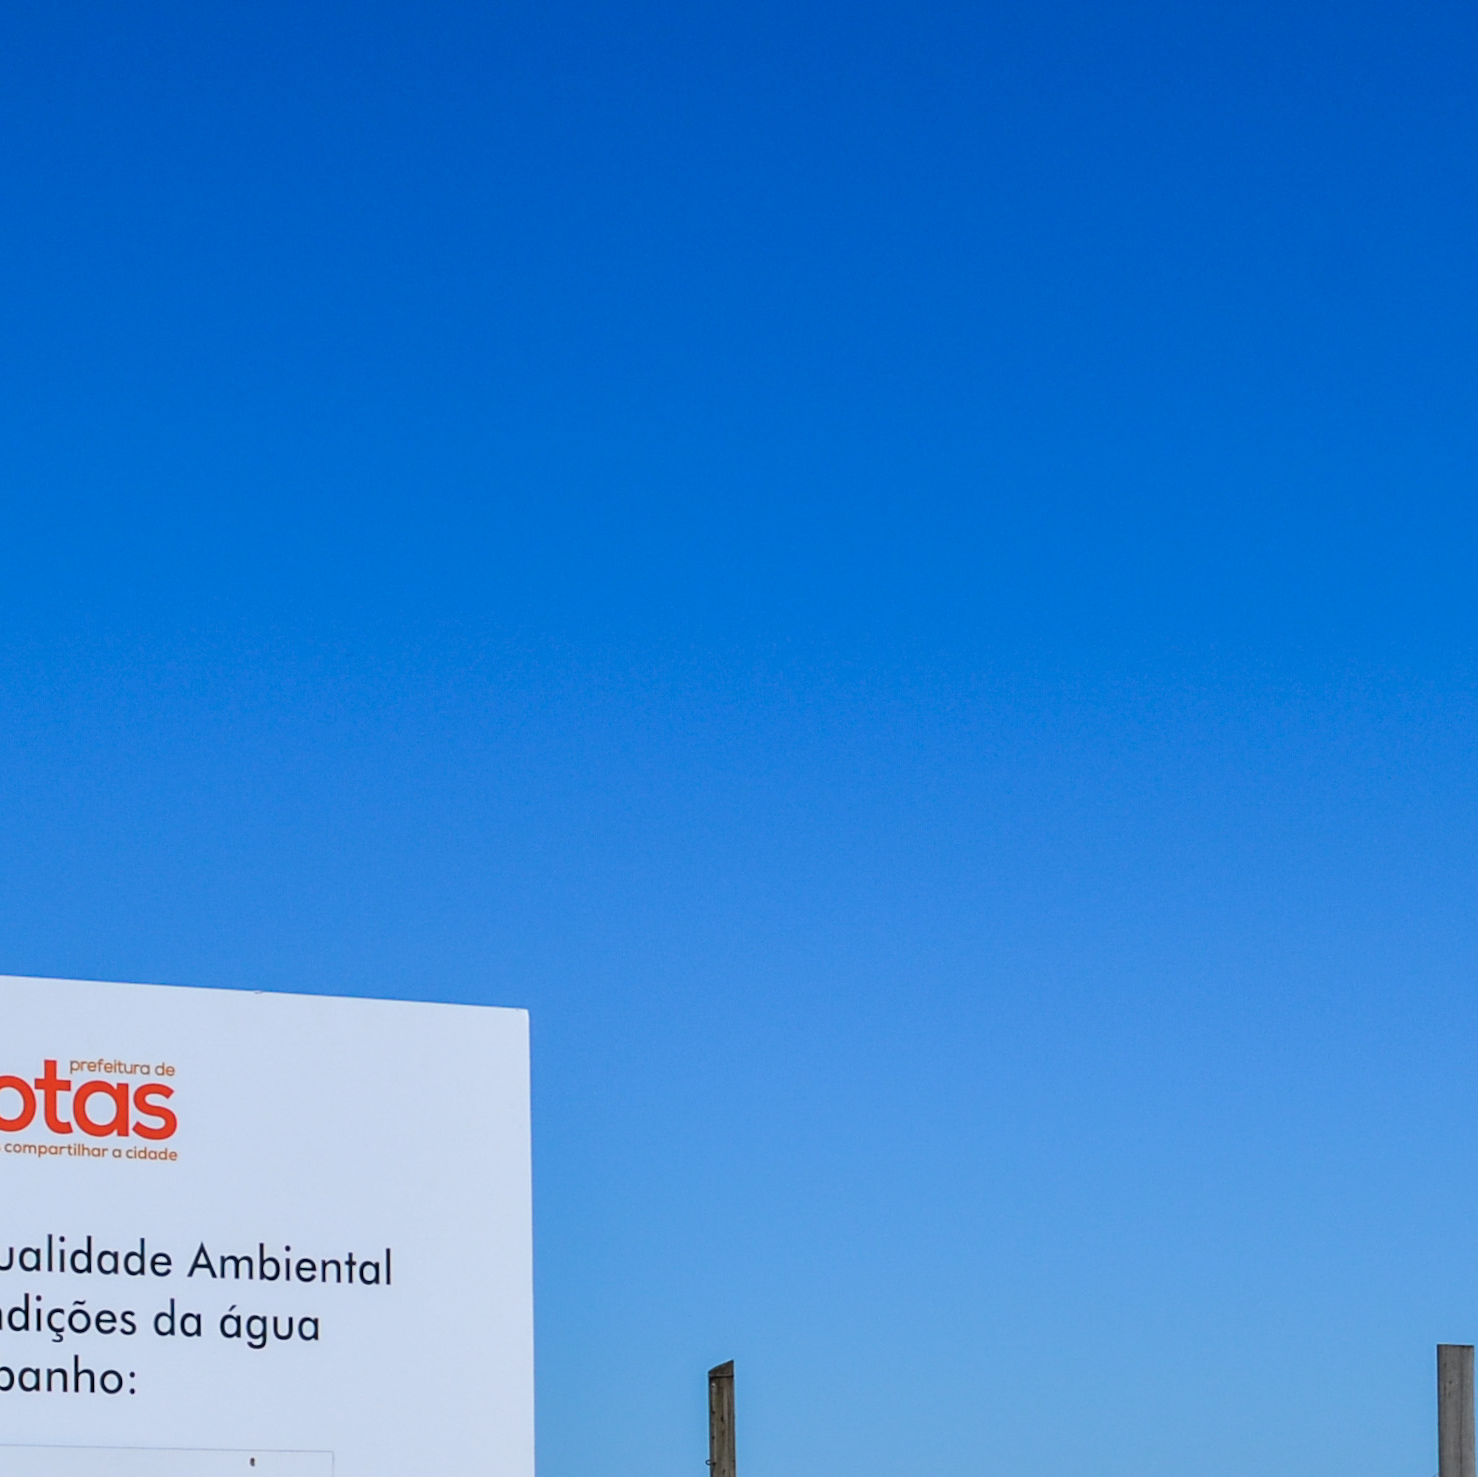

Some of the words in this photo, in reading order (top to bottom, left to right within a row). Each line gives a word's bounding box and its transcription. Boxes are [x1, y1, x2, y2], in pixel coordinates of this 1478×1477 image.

[69, 1059, 151, 1076] prefeitura
[155, 1061, 176, 1077] de
[4, 1142, 108, 1158] compartilhar
[111, 1149, 122, 1159] a
[125, 1147, 178, 1161] cidade
[186, 1241, 392, 1286] Ambiental
[153, 1298, 203, 1338] da
[219, 1304, 320, 1350] água
